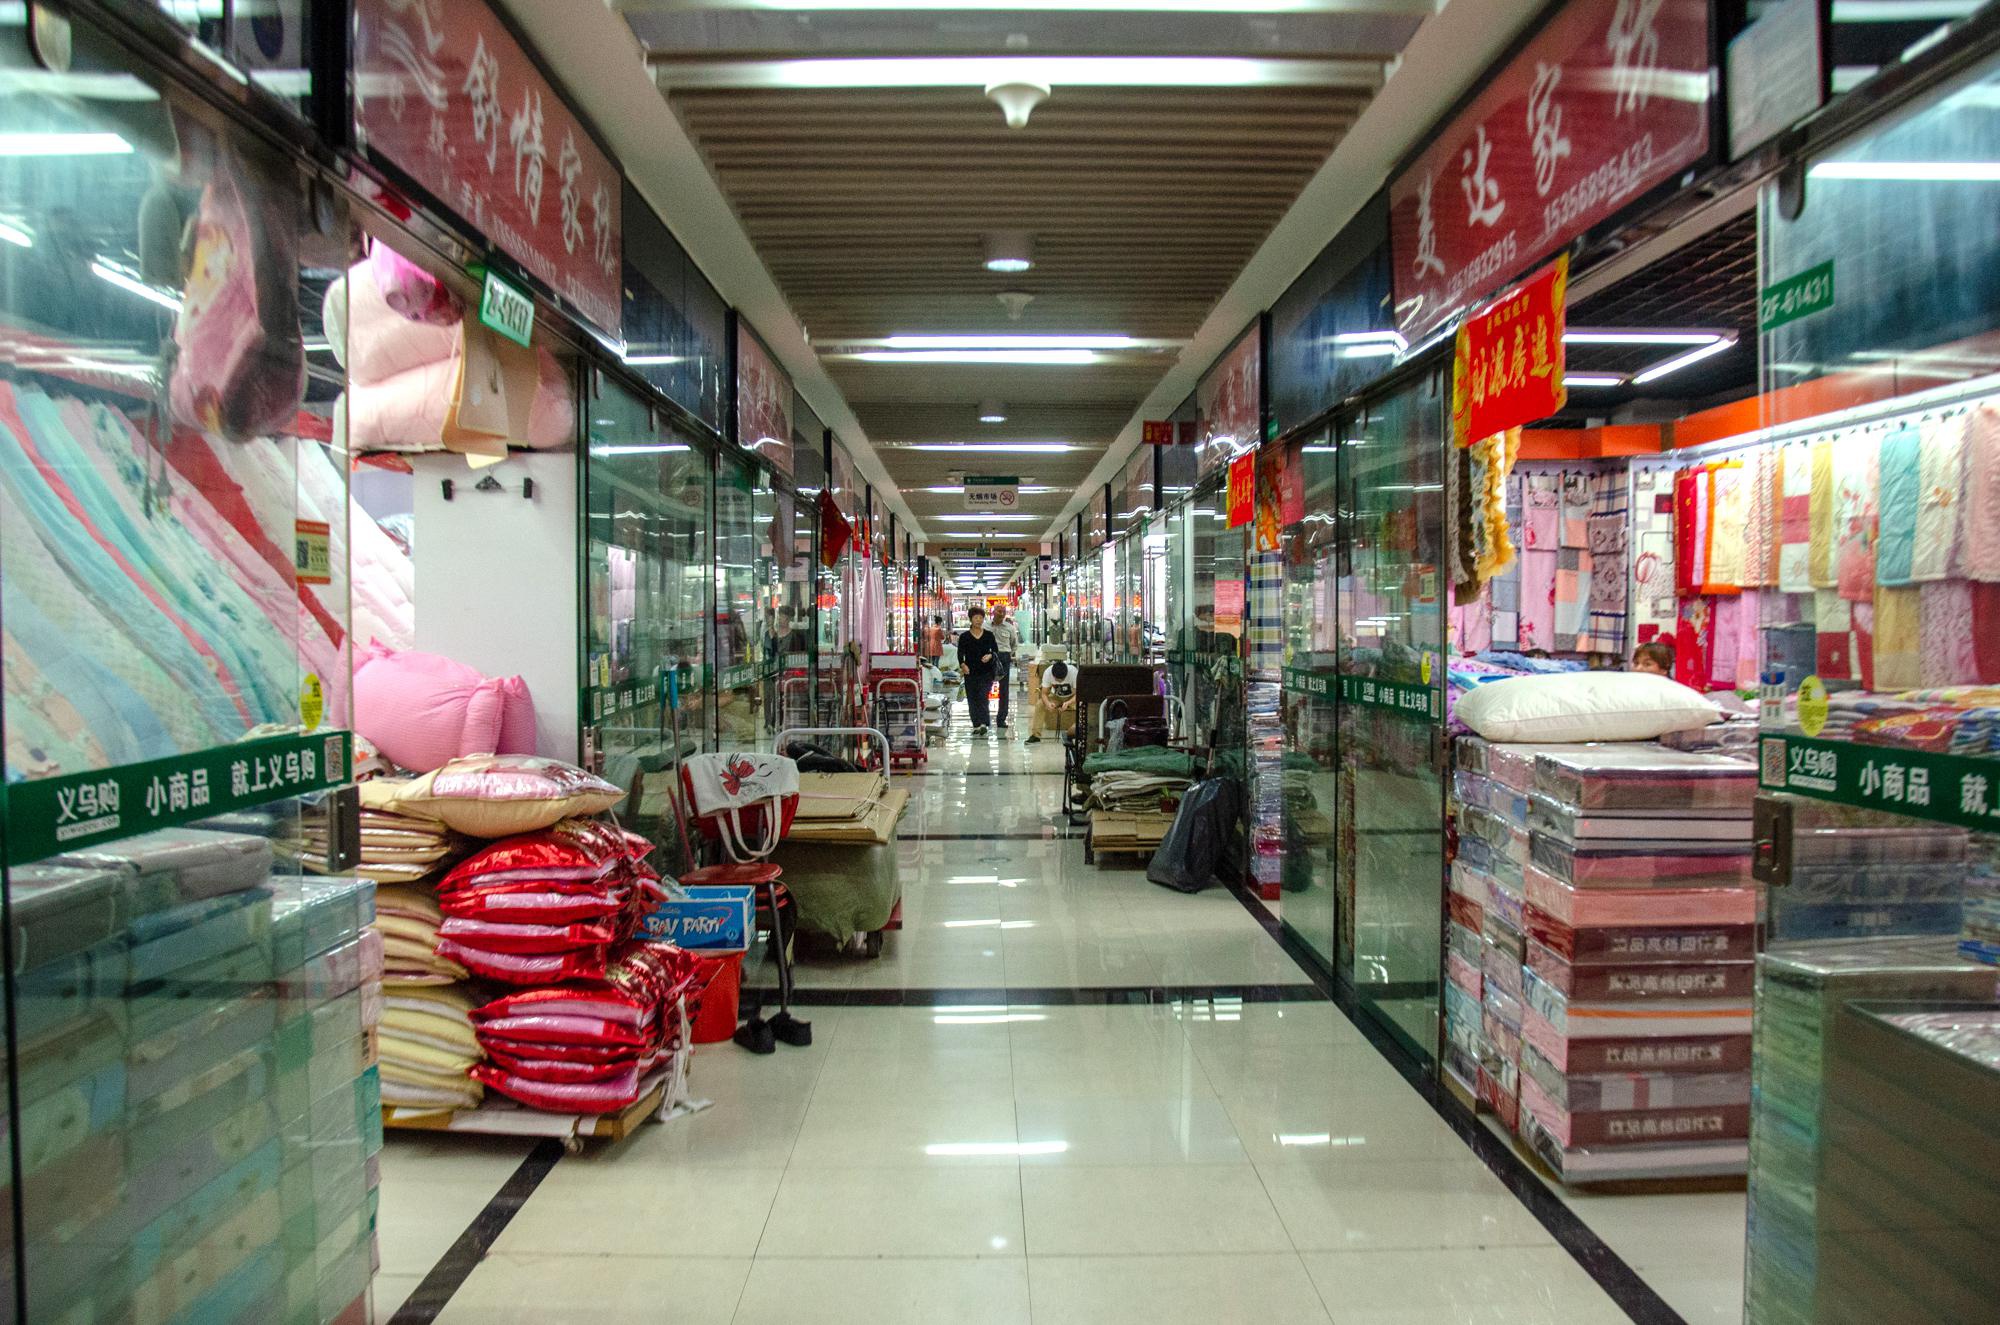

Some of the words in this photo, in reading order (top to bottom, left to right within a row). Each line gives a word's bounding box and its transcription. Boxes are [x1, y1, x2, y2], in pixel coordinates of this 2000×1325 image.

[1413, 0, 1660, 280] 美达家纺
[1763, 271, 1831, 321] 2F-61431
[56, 778, 120, 824] 义乌购
[146, 769, 210, 817] 小商品
[230, 750, 316, 797] 就上义乌购
[1789, 745, 1837, 778] 义乌购
[1859, 760, 1931, 806] 小商品
